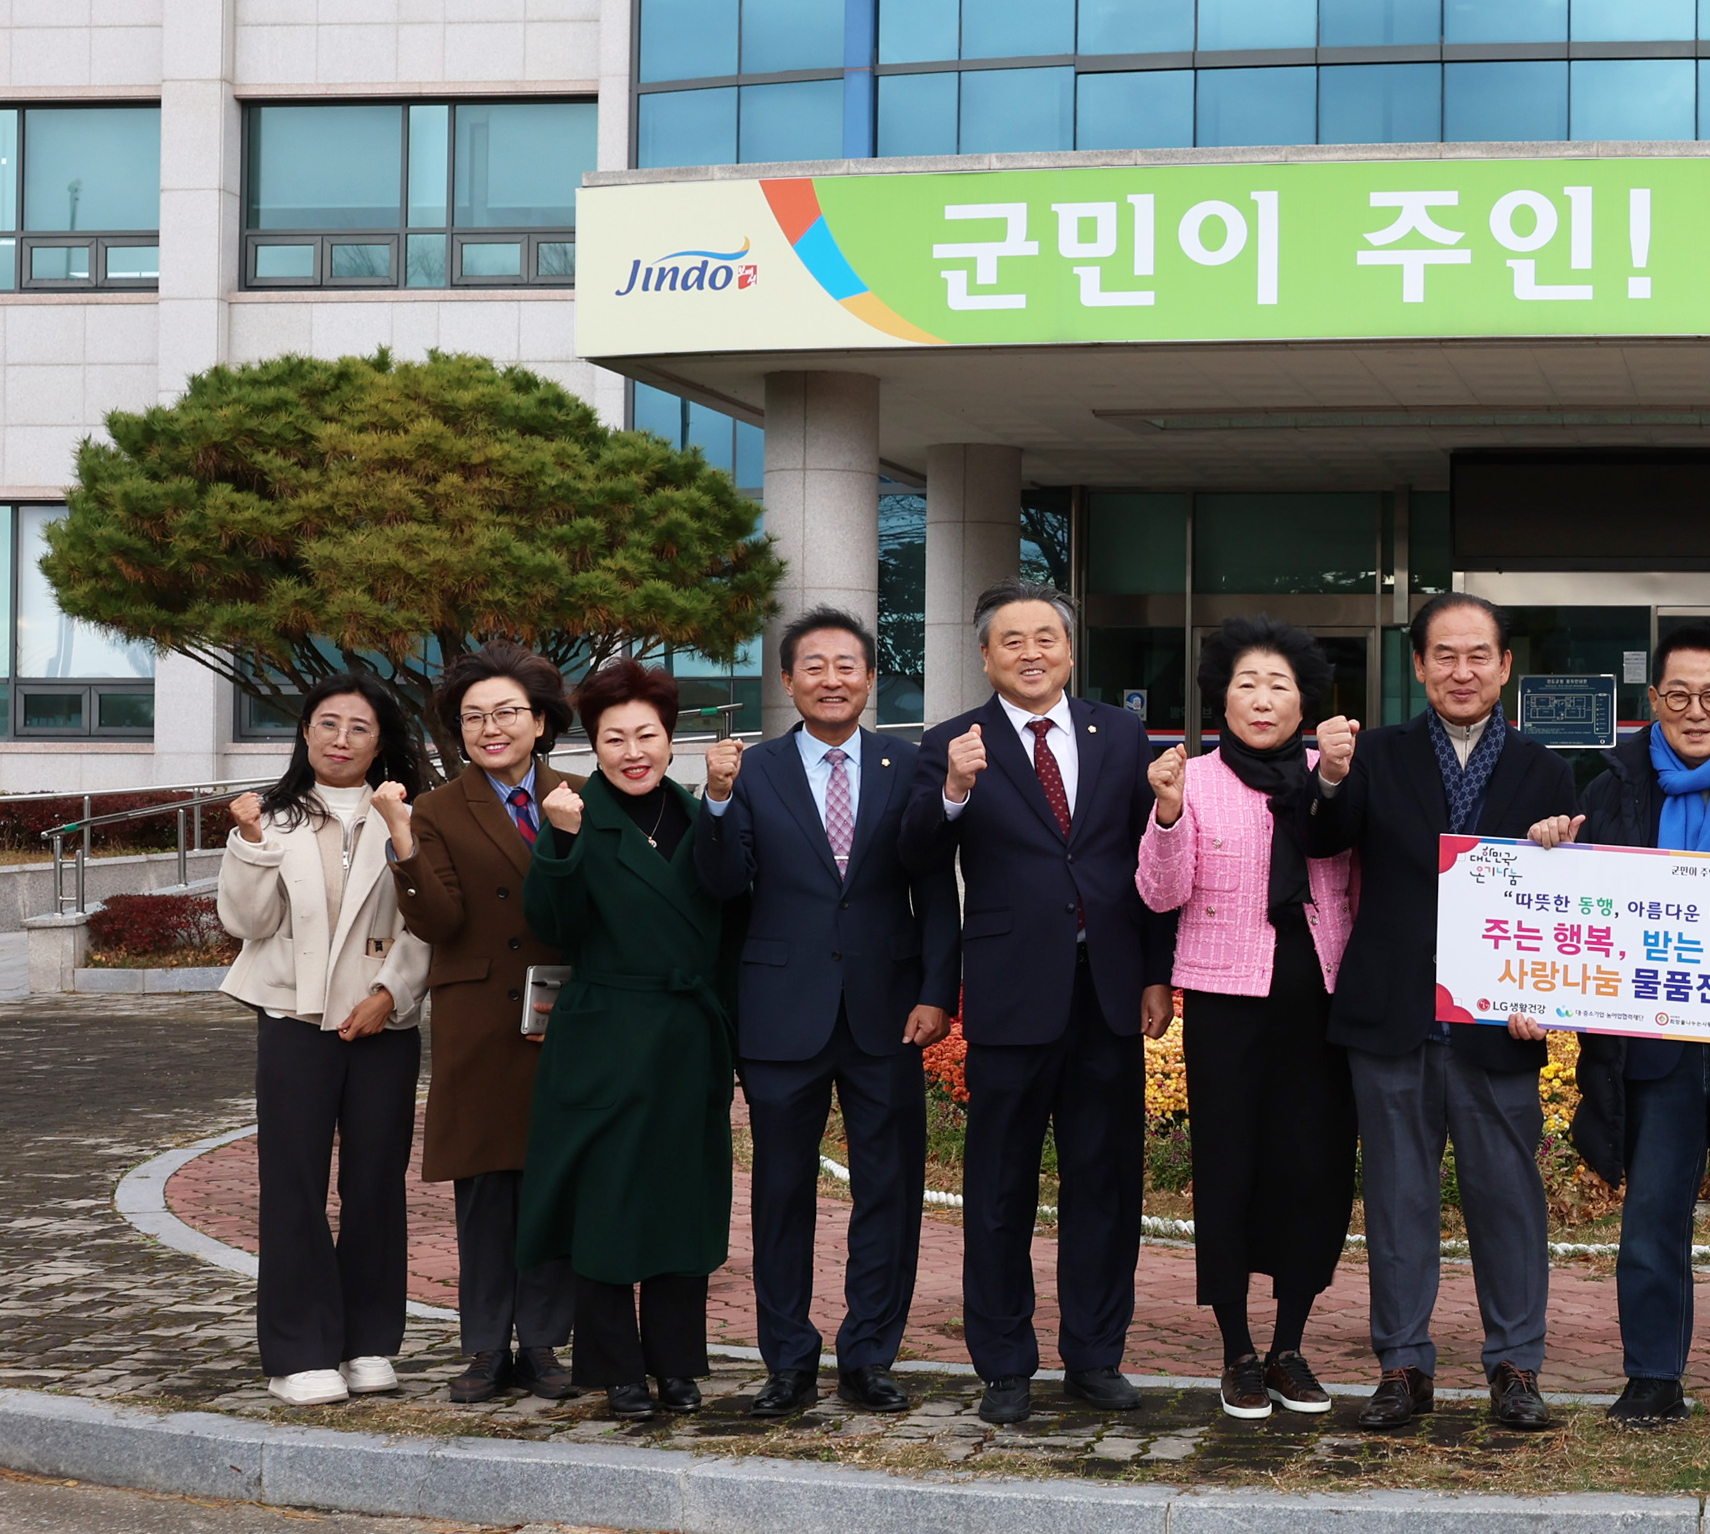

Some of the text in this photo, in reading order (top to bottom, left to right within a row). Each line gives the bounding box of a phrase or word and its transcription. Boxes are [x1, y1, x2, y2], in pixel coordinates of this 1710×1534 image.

[933, 191, 1278, 310] 군민이
[1357, 187, 1651, 302] 주인!
[616, 258, 734, 295] Jindo
[1468, 846, 1517, 866] 대한민국
[1671, 864, 1697, 878] 군민이
[1470, 866, 1522, 886] 온기나눔
[1504, 891, 1570, 913] “따뜻한
[1579, 897, 1618, 918] 동행,
[1628, 902, 1700, 922] 아름다운
[1482, 919, 1543, 952] 주는
[1554, 923, 1625, 960] 행복,
[1643, 930, 1703, 964] 받는
[1498, 957, 1624, 996] 사랑나눔
[1492, 1000, 1547, 1014] LG 생활건강
